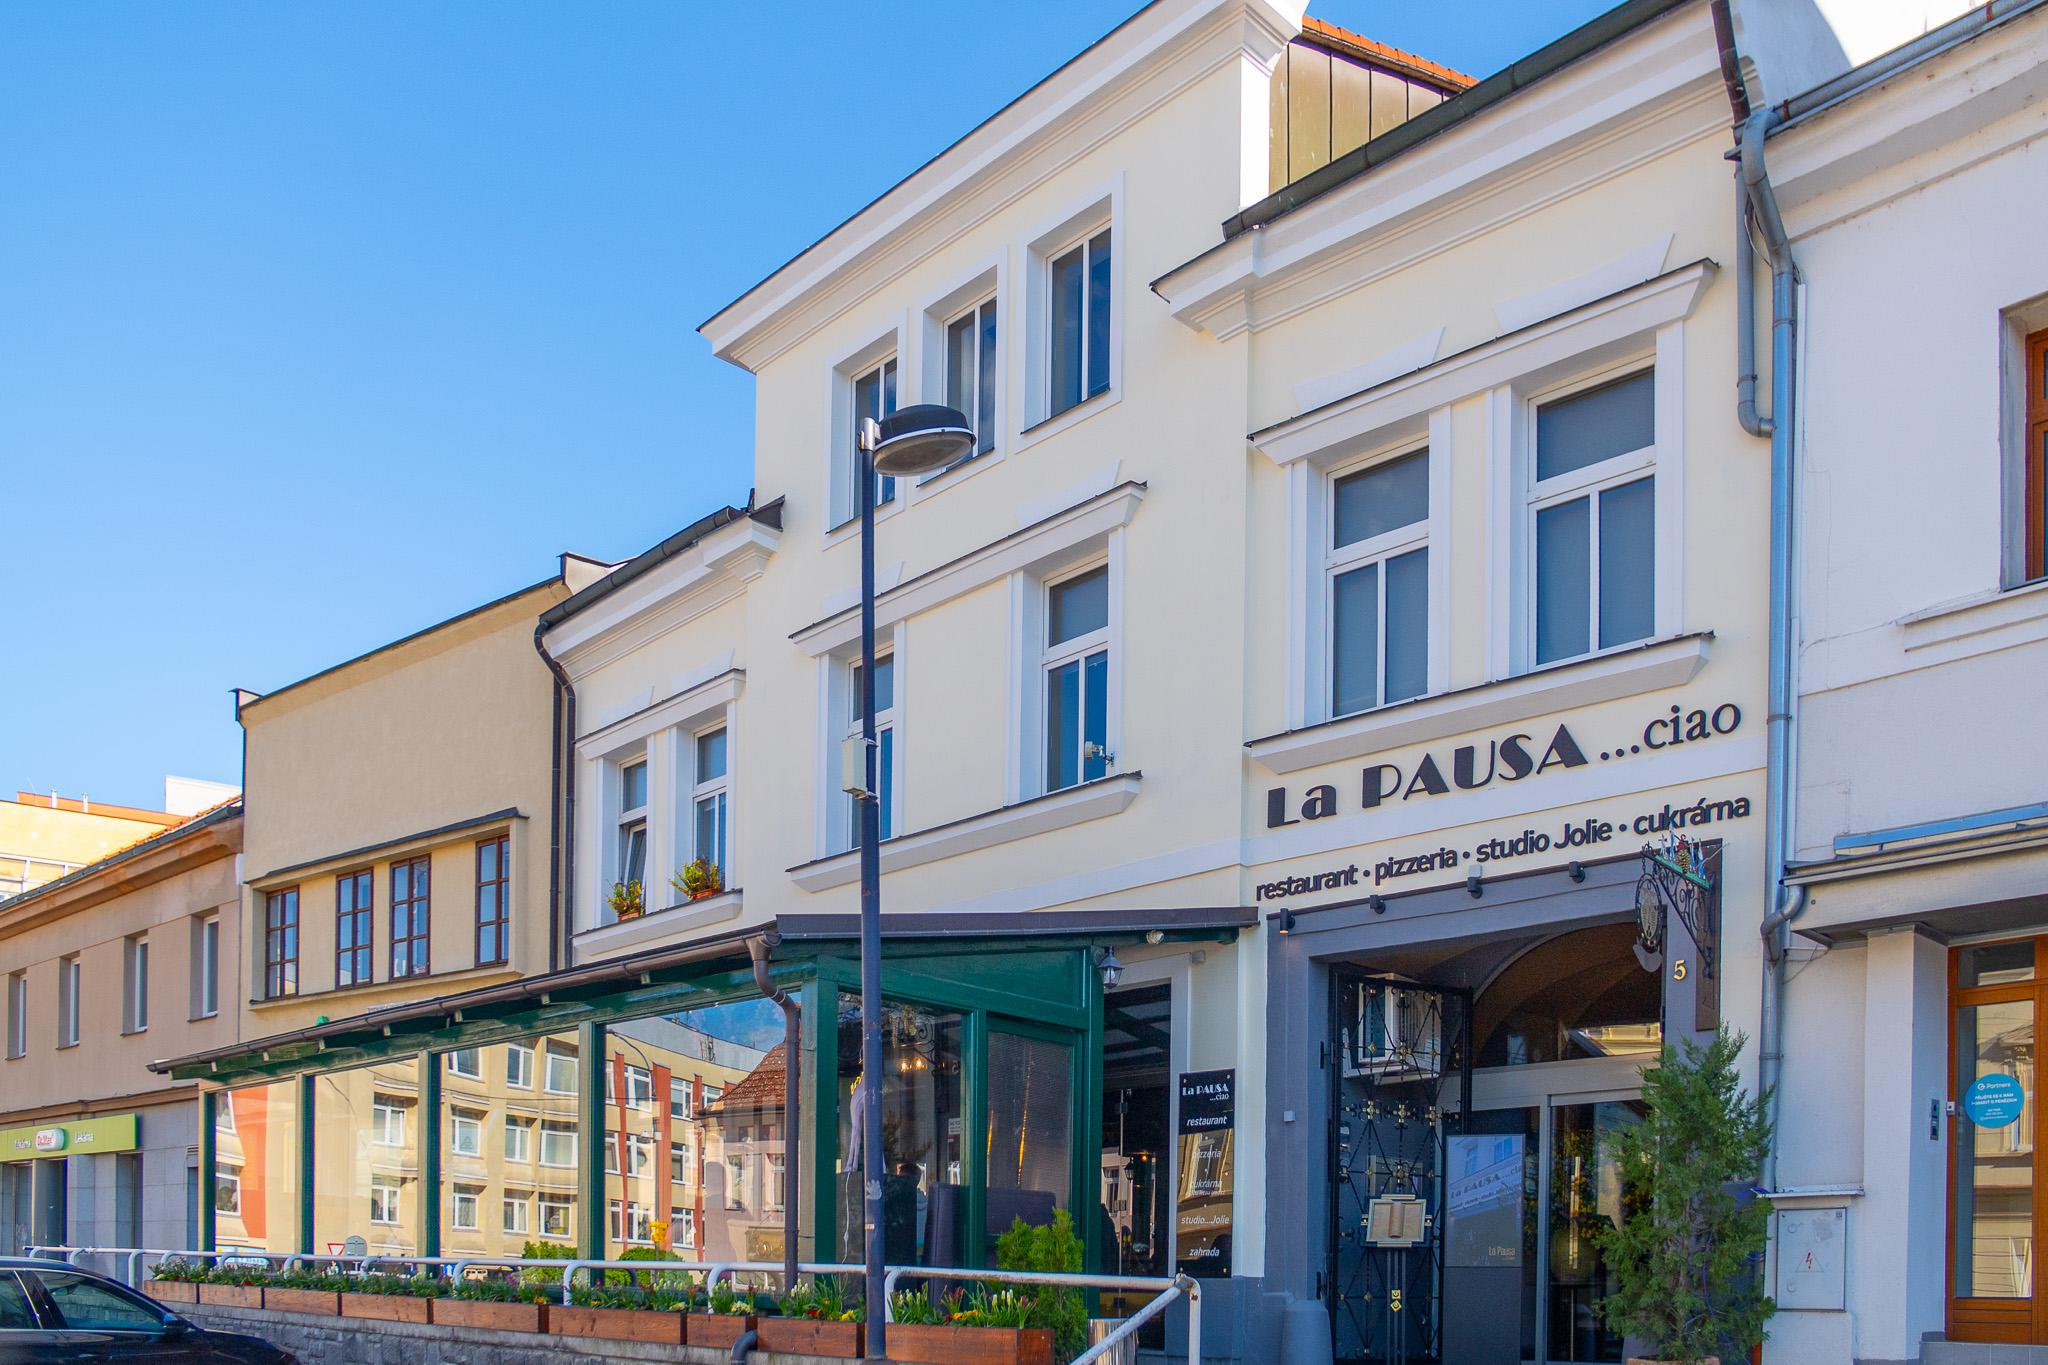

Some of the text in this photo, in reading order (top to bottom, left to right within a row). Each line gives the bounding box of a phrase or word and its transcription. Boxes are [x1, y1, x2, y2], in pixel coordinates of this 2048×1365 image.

[1267, 783, 1337, 829] La
[1361, 723, 1589, 809] PAUSA
[1256, 796, 1751, 902] restaurant pizzeria studio Jolie cukrárna
[1673, 959, 1687, 981] 5
[1182, 1083, 1229, 1096] La PAUSA
[1186, 1115, 1228, 1127] restaurant
[1188, 1246, 1220, 1257] zahrada
[1488, 1245, 1516, 1256] La Pausa
